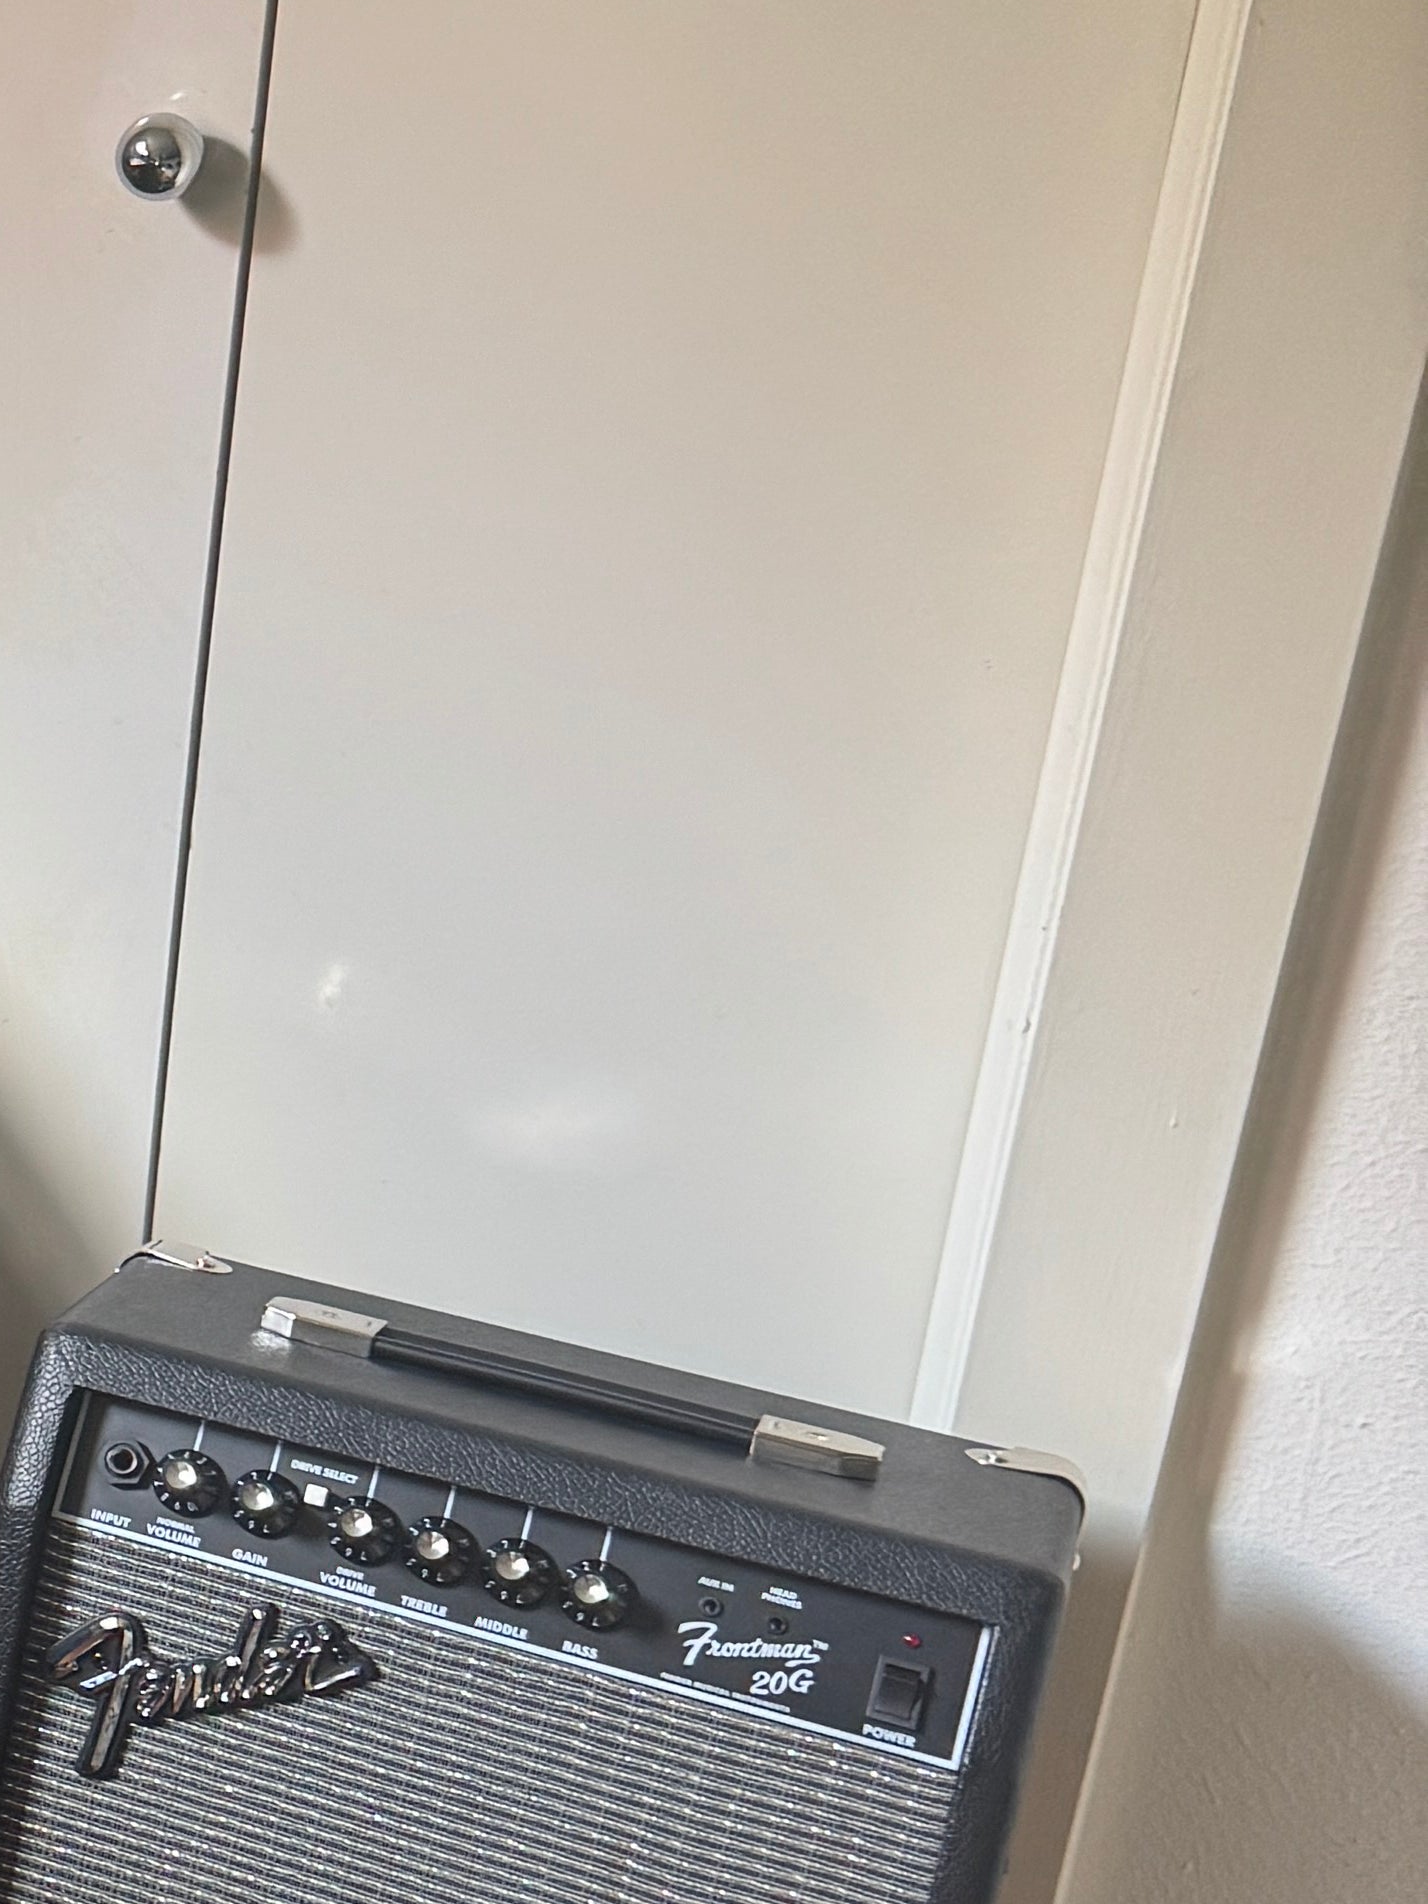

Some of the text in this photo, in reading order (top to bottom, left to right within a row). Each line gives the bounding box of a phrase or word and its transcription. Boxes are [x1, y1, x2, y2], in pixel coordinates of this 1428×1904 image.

[290, 1459, 359, 1484] DRIVE SELECT
[90, 1508, 132, 1528] INPUT
[146, 1523, 201, 1548] VOLUME
[232, 1548, 268, 1567] GAIN
[320, 1570, 376, 1598] VOLUME
[400, 1594, 448, 1618] TREBLE
[474, 1616, 528, 1640] MIDDLE
[561, 1640, 599, 1660] BASS
[47, 1602, 381, 1780] Fender
[749, 1669, 815, 1695] 20G
[862, 1724, 917, 1747] POWER
